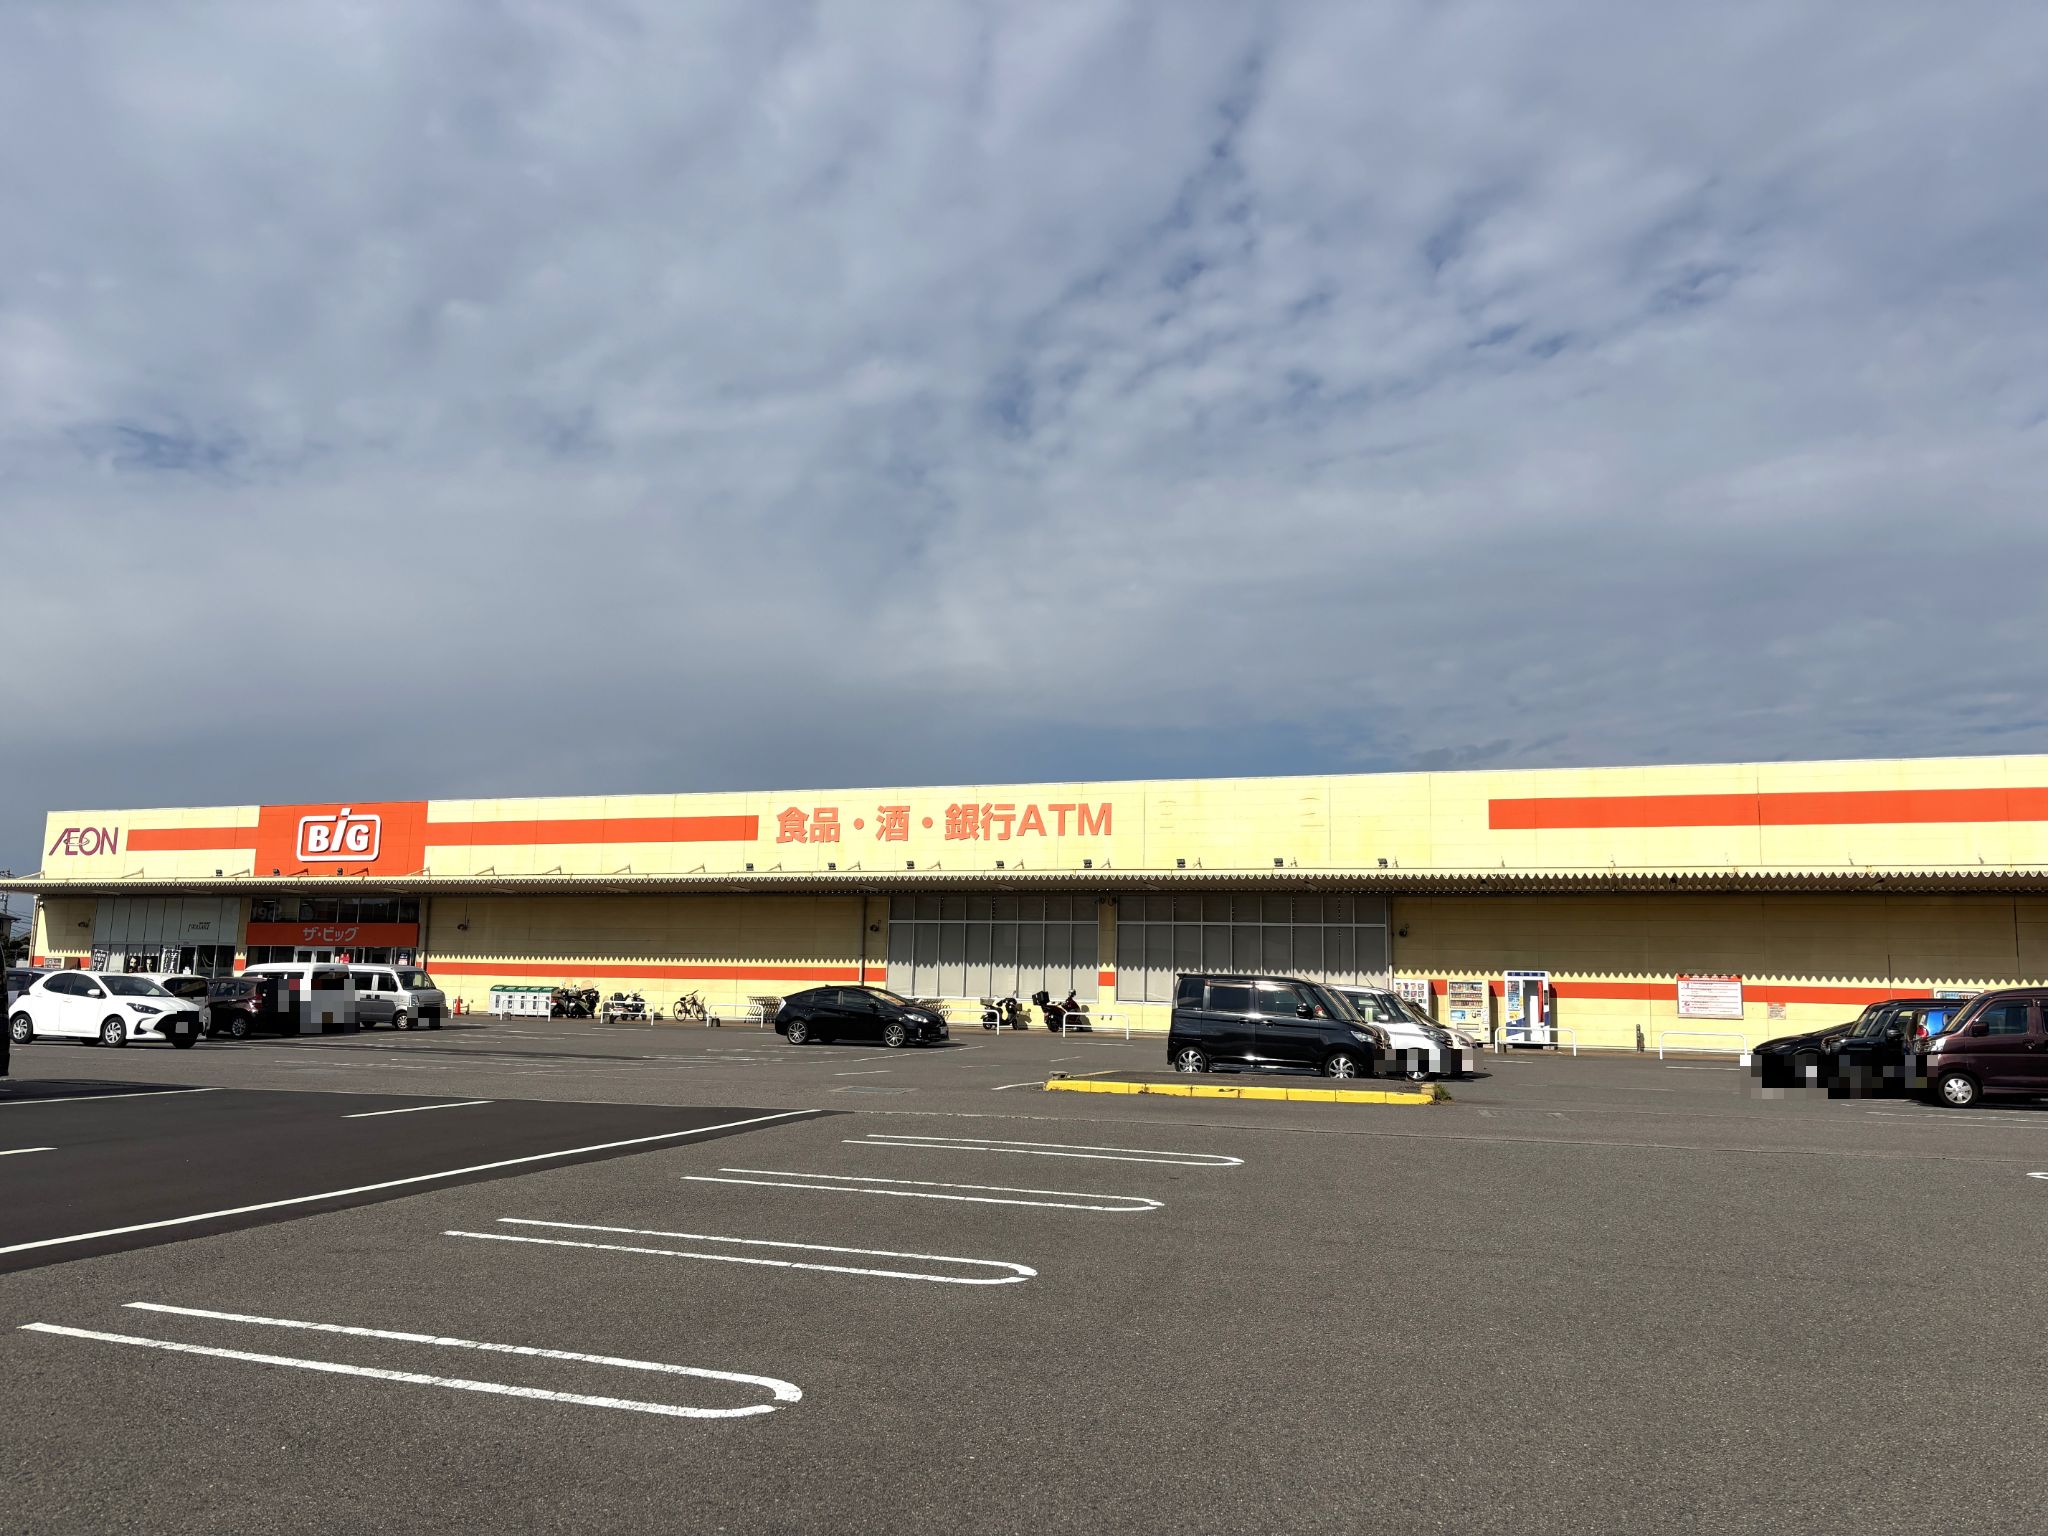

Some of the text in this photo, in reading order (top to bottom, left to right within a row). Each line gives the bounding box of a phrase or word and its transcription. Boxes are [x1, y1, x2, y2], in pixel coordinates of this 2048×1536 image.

[303, 926, 359, 942] ザ・ビッグ
